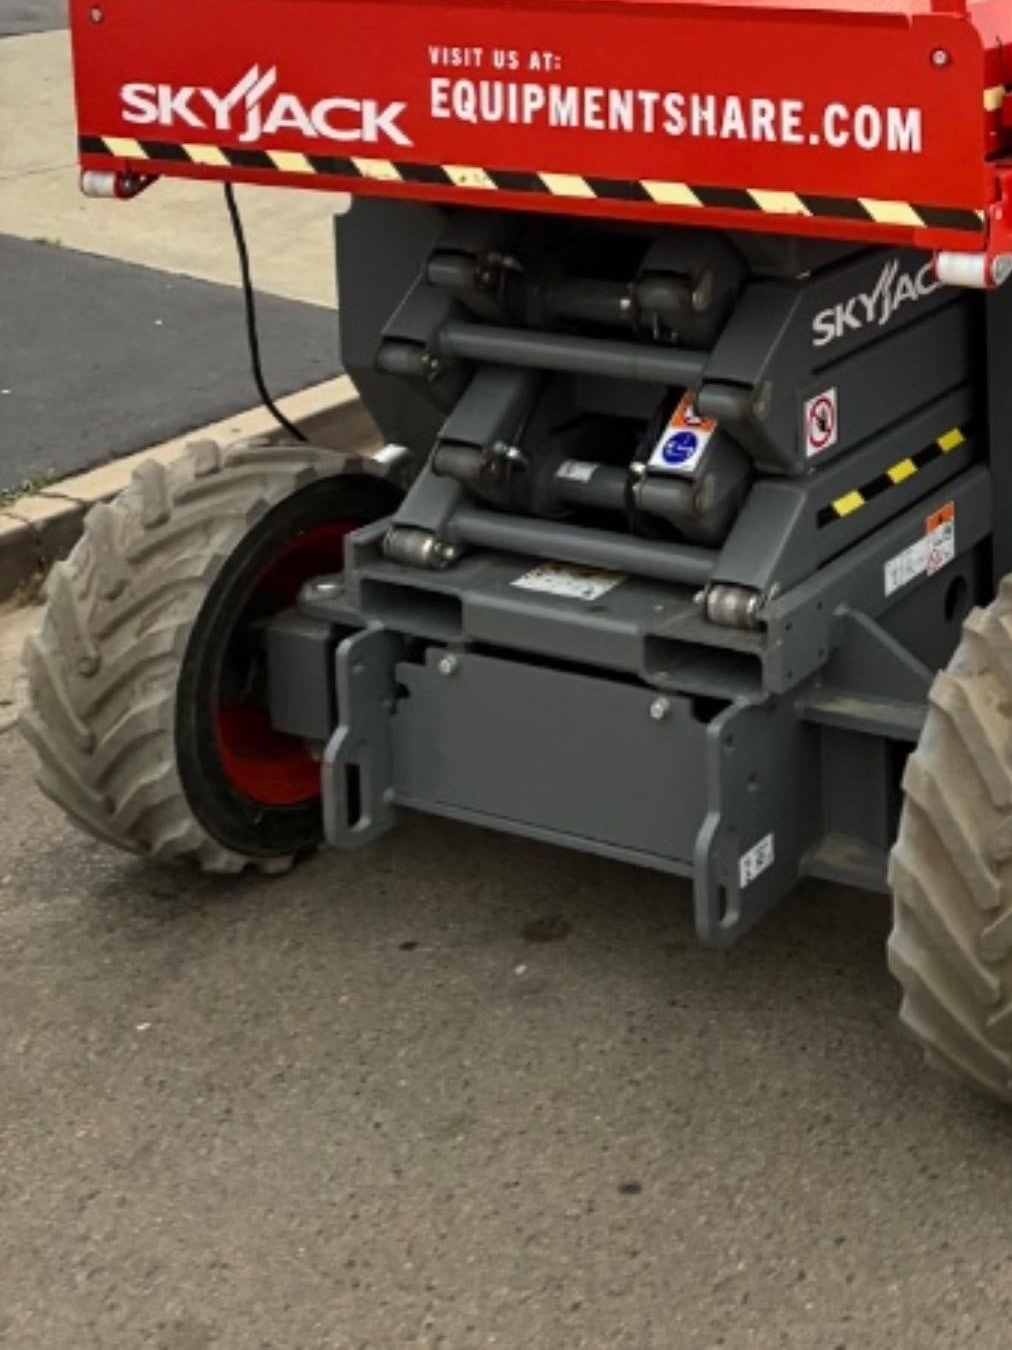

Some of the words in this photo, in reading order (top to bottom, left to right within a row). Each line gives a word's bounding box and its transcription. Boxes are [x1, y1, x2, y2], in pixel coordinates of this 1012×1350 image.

[428, 46, 483, 67] VISIT
[493, 50, 519, 70] US
[528, 52, 562, 71] AT:
[120, 64, 413, 147] SKYJACK
[430, 78, 923, 152] EQUIPMENTSHARE.COM
[812, 258, 942, 347] SKYJAC
